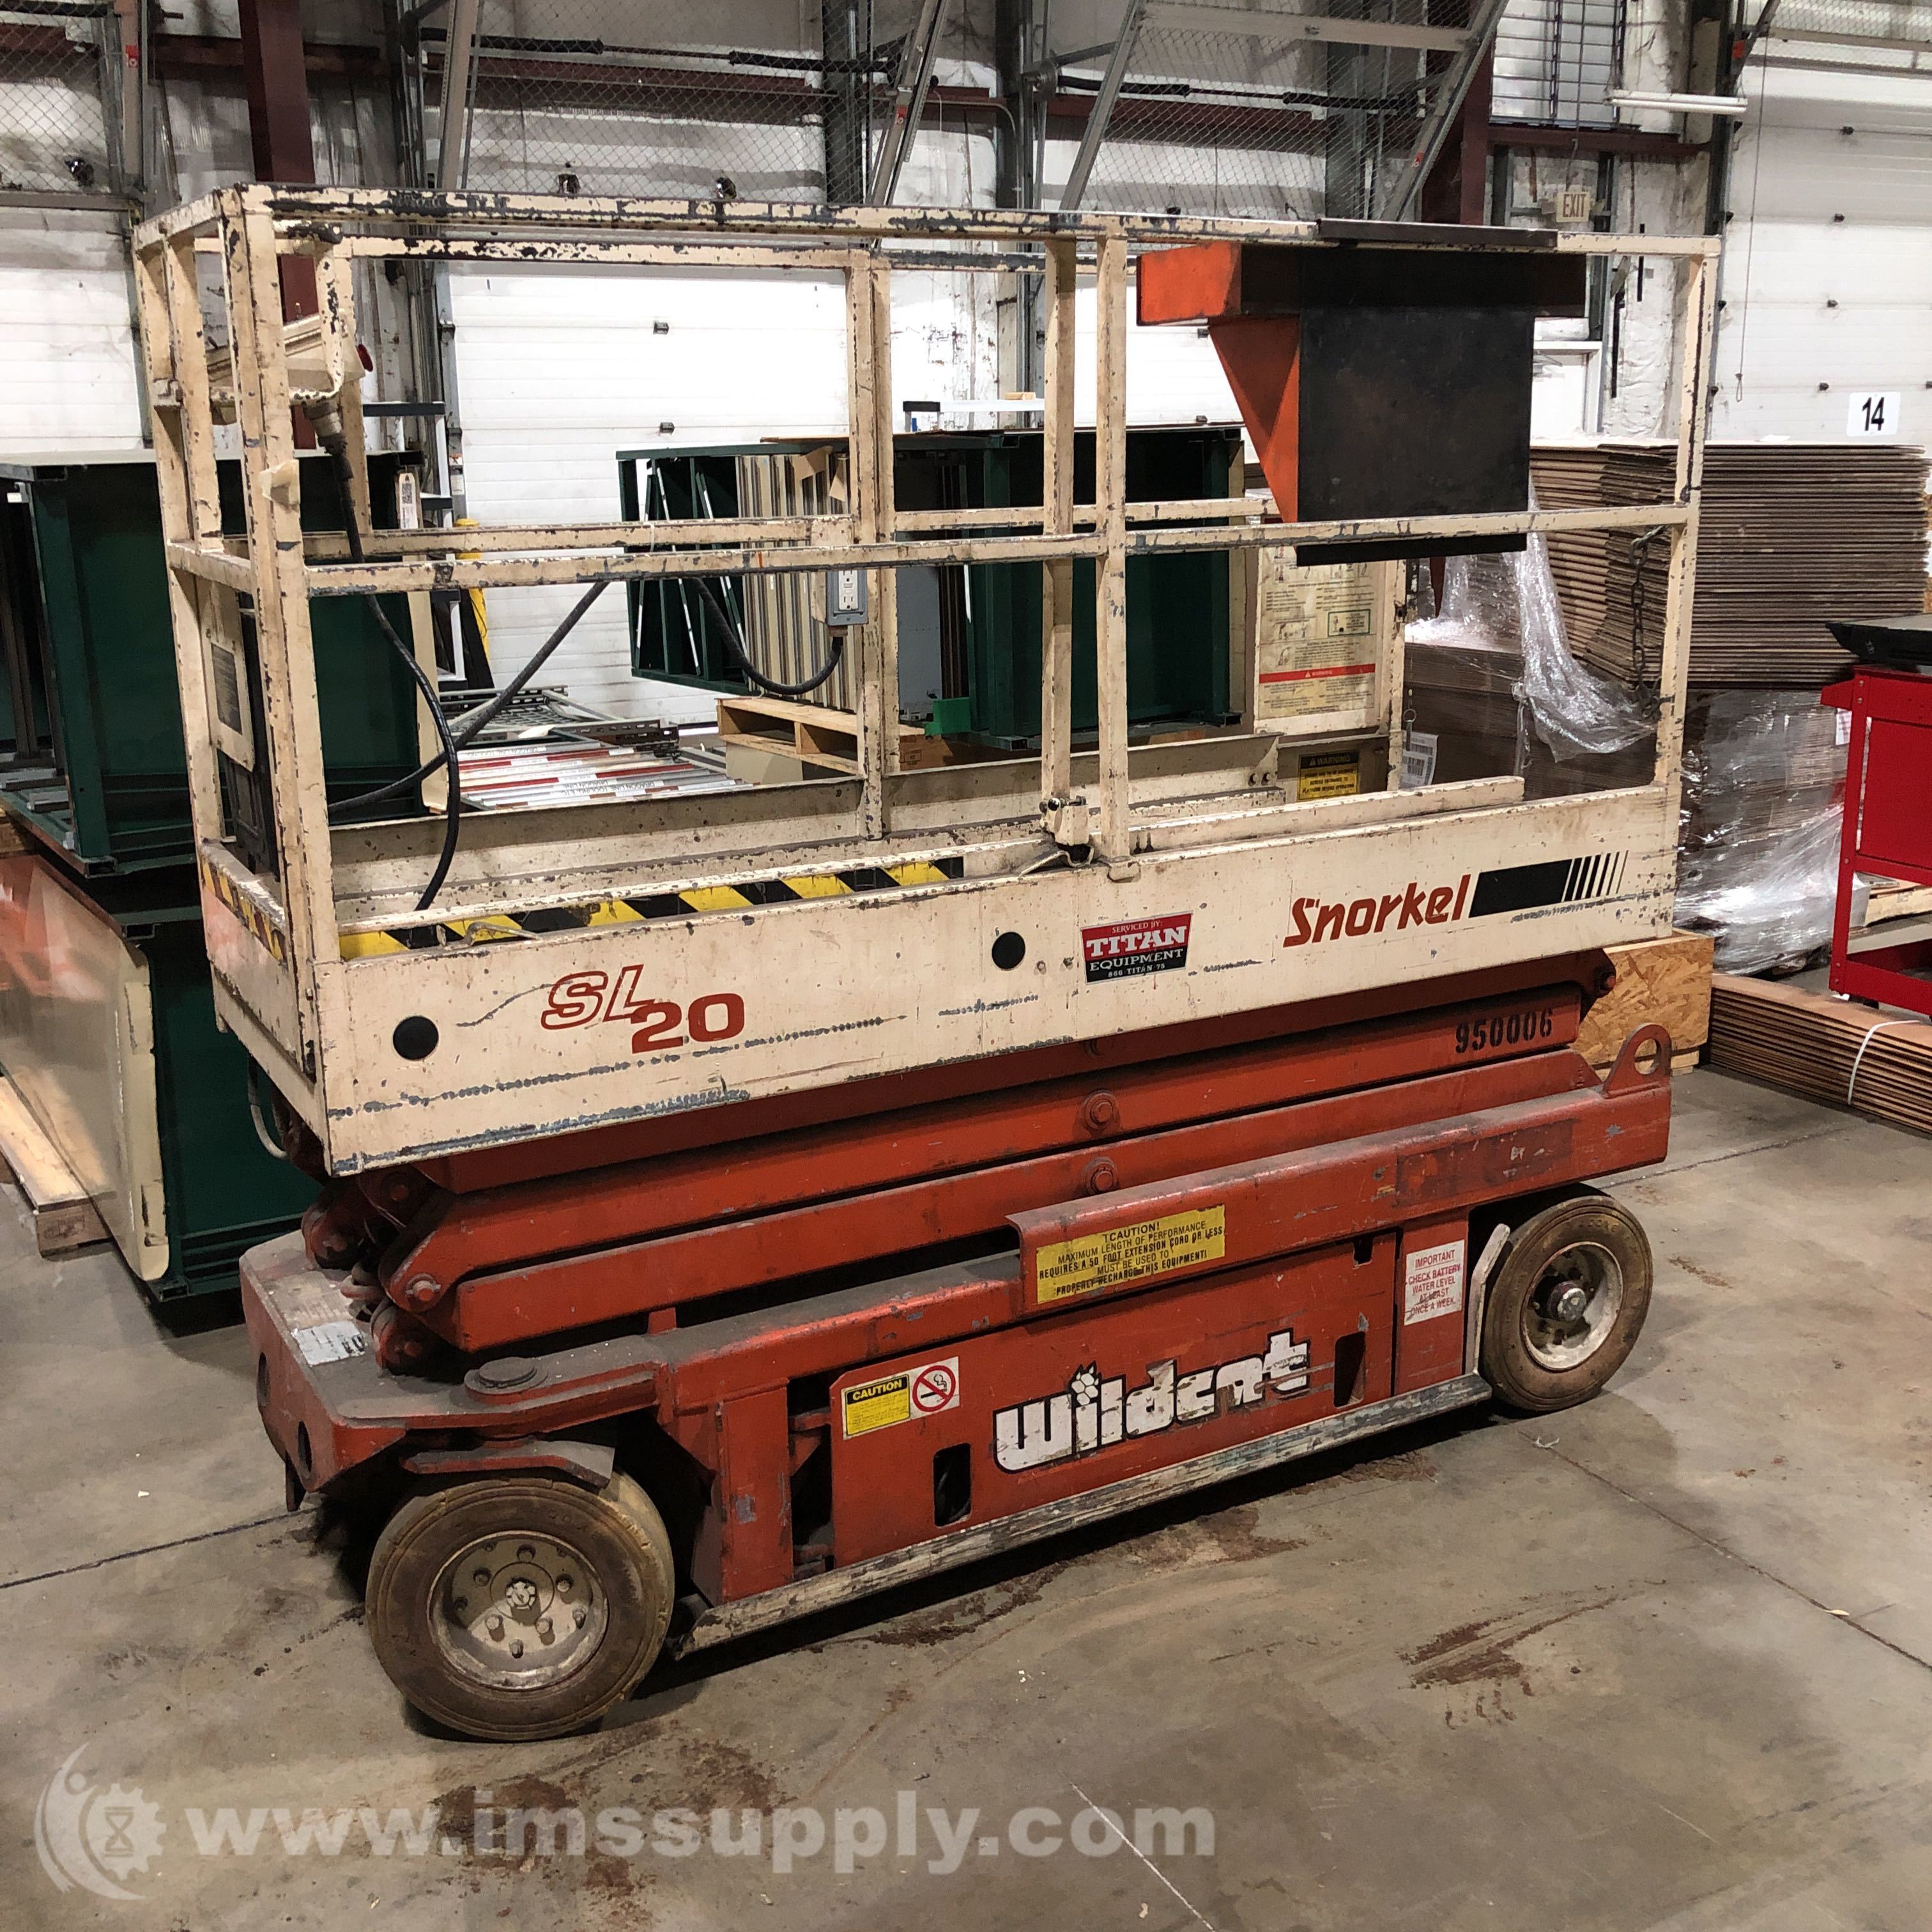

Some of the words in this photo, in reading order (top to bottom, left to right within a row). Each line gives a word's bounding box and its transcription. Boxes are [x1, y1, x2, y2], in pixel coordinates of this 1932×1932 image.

[1562, 194, 1586, 217] EXIT
[1862, 397, 1885, 431] 14
[1317, 755, 1351, 765] WARNING
[1283, 873, 1471, 948] Snorkel
[1112, 921, 1149, 933] SERVICED
[1086, 926, 1187, 957] TITAN
[1089, 948, 1184, 972] EQUIPMENT
[1127, 965, 1153, 975] TITAN
[1455, 1008, 1553, 1054] 950006
[1039, 1262, 1078, 1280] REQUIRES
[1081, 1260, 1086, 1269] A
[1089, 1257, 1099, 1268] 50
[1103, 1251, 1121, 1264] FOOT
[1124, 1239, 1166, 1258] EXTENSION
[1169, 1234, 1189, 1247] CORD
[1192, 1232, 1202, 1241] OR
[1205, 1226, 1223, 1238] LESS
[1058, 1247, 1098, 1264] MAXIMUM
[1101, 1239, 1132, 1254] LENGTH
[1135, 1236, 1146, 1245] OF
[1148, 1220, 1206, 1242] PERFORMANCE
[1097, 1262, 1119, 1275] MUST
[1123, 1259, 1133, 1269] BE
[1135, 1252, 1157, 1266] USED
[1160, 1249, 1169, 1259] TO
[1415, 1250, 1455, 1268] IMPORTANT
[1056, 1278, 1094, 1296] PROPERLY
[1141, 1262, 1158, 1274] THIS
[1408, 1271, 1430, 1285] CHECK
[1432, 1263, 1461, 1279] BATTERY
[1412, 1281, 1435, 1294] WATER
[1436, 1276, 1456, 1288] LEVEL
[1410, 1303, 1429, 1316] ONCE
[1430, 1301, 1435, 1310] A
[1419, 1293, 1427, 1304] AT
[852, 1379, 903, 1401] CAUTION
